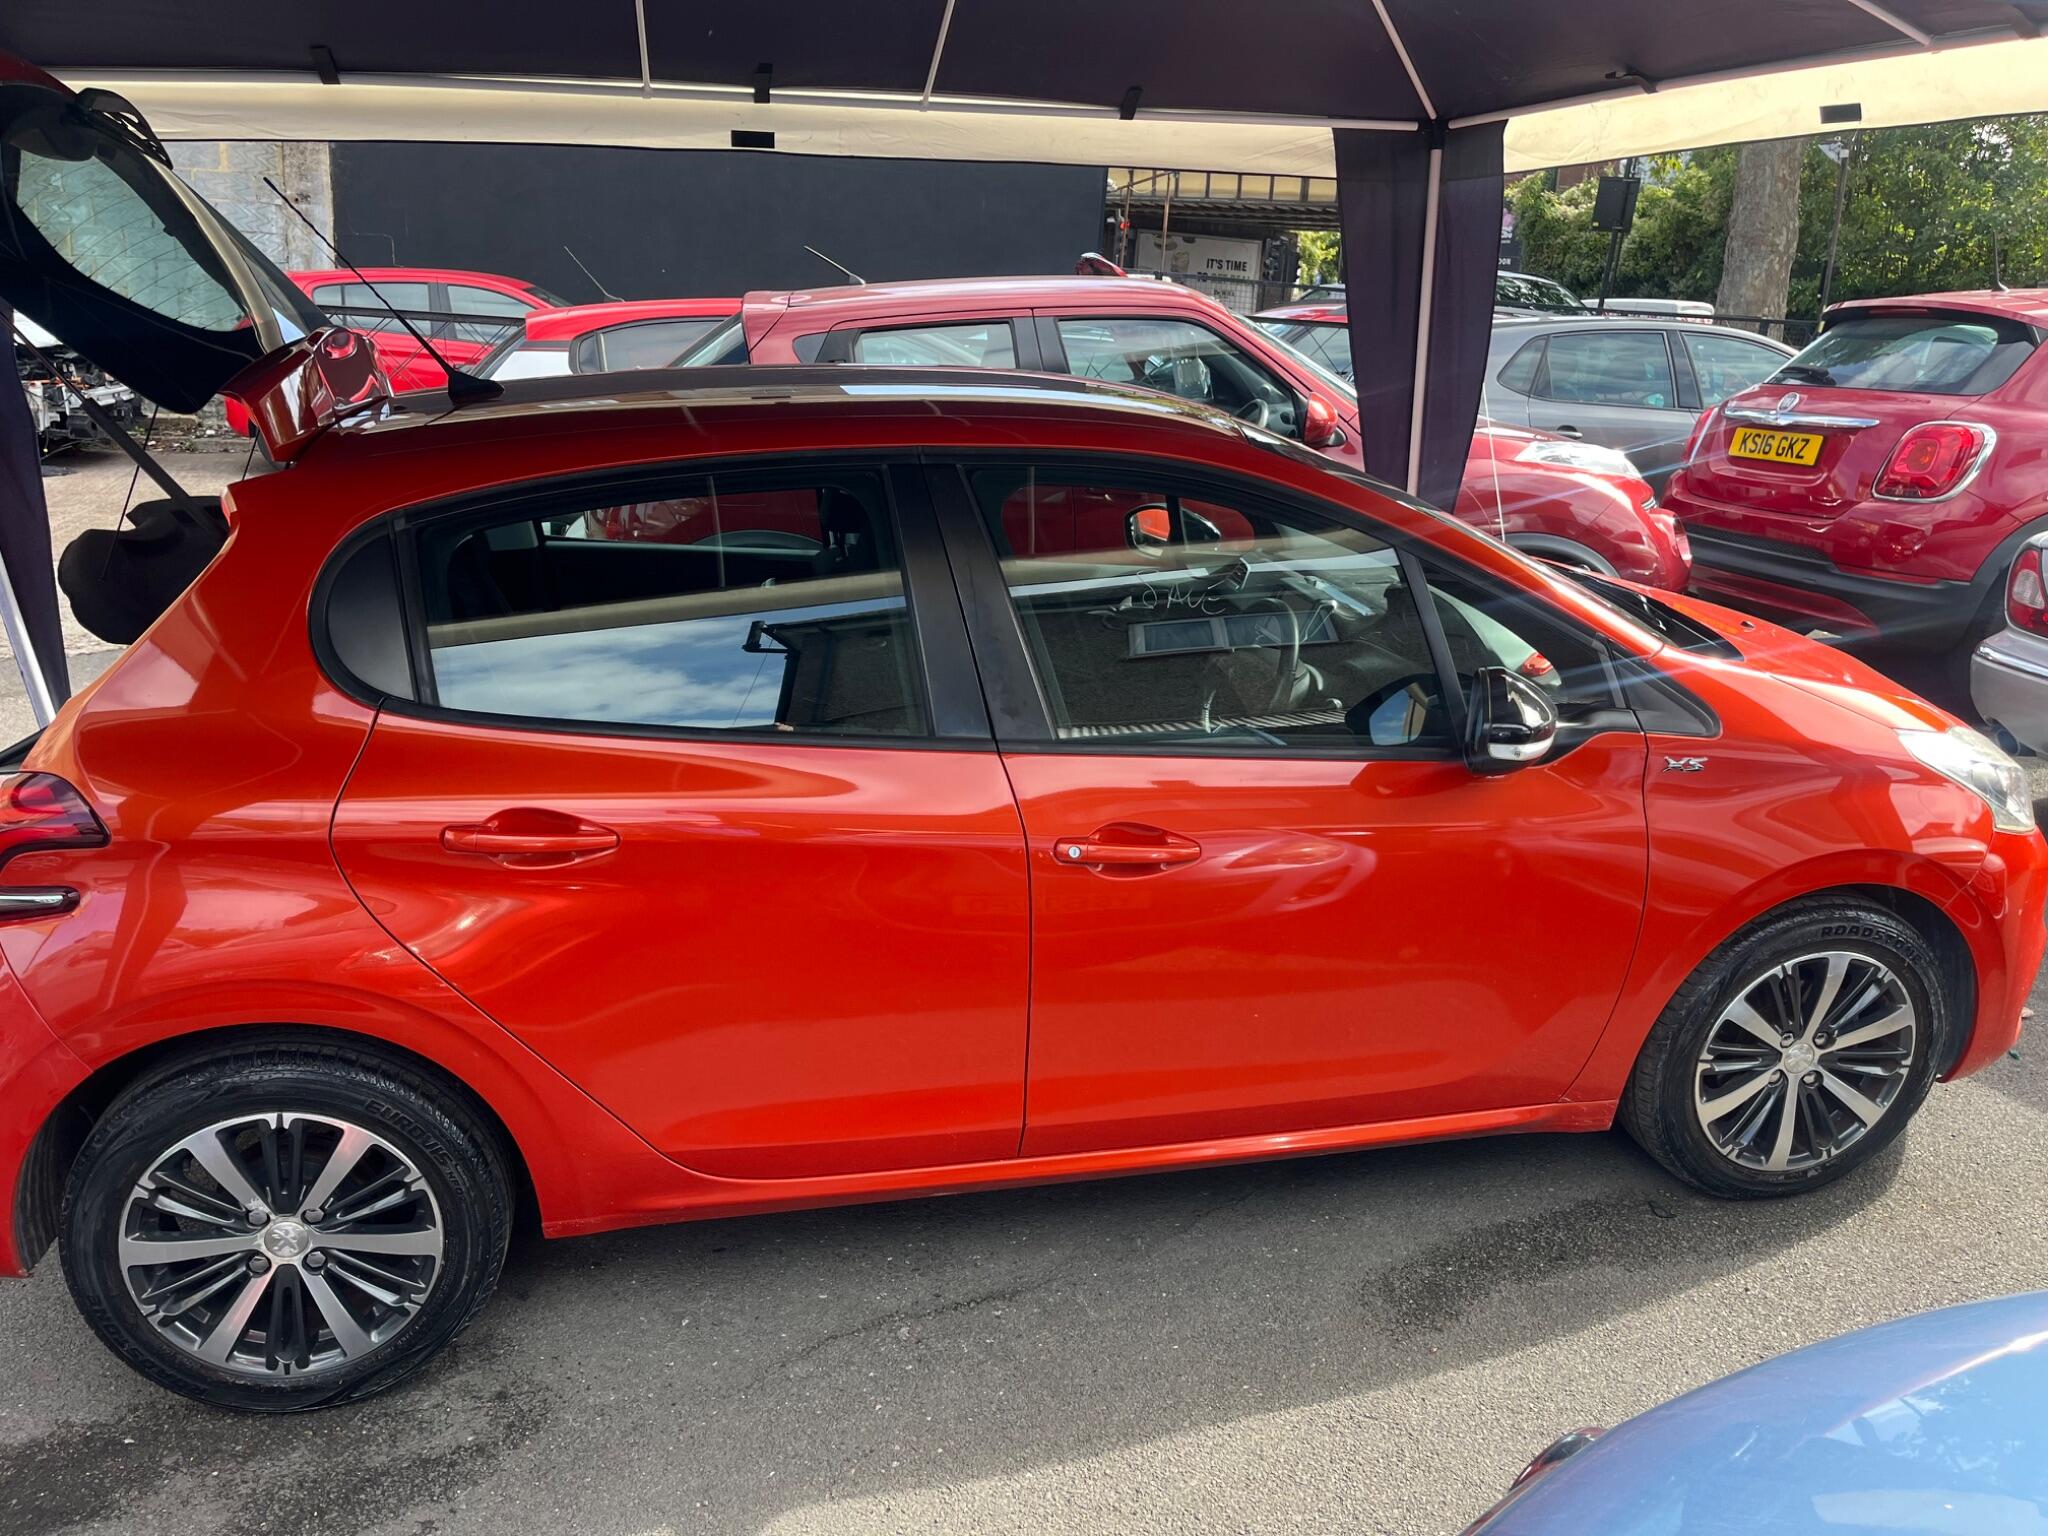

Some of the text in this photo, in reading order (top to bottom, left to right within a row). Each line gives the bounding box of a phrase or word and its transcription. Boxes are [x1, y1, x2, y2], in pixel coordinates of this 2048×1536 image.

[1206, 258, 1248, 272] IT'S TIME
[1738, 432, 1811, 460] KS16 GKZ
[1662, 755, 1709, 773] XS
